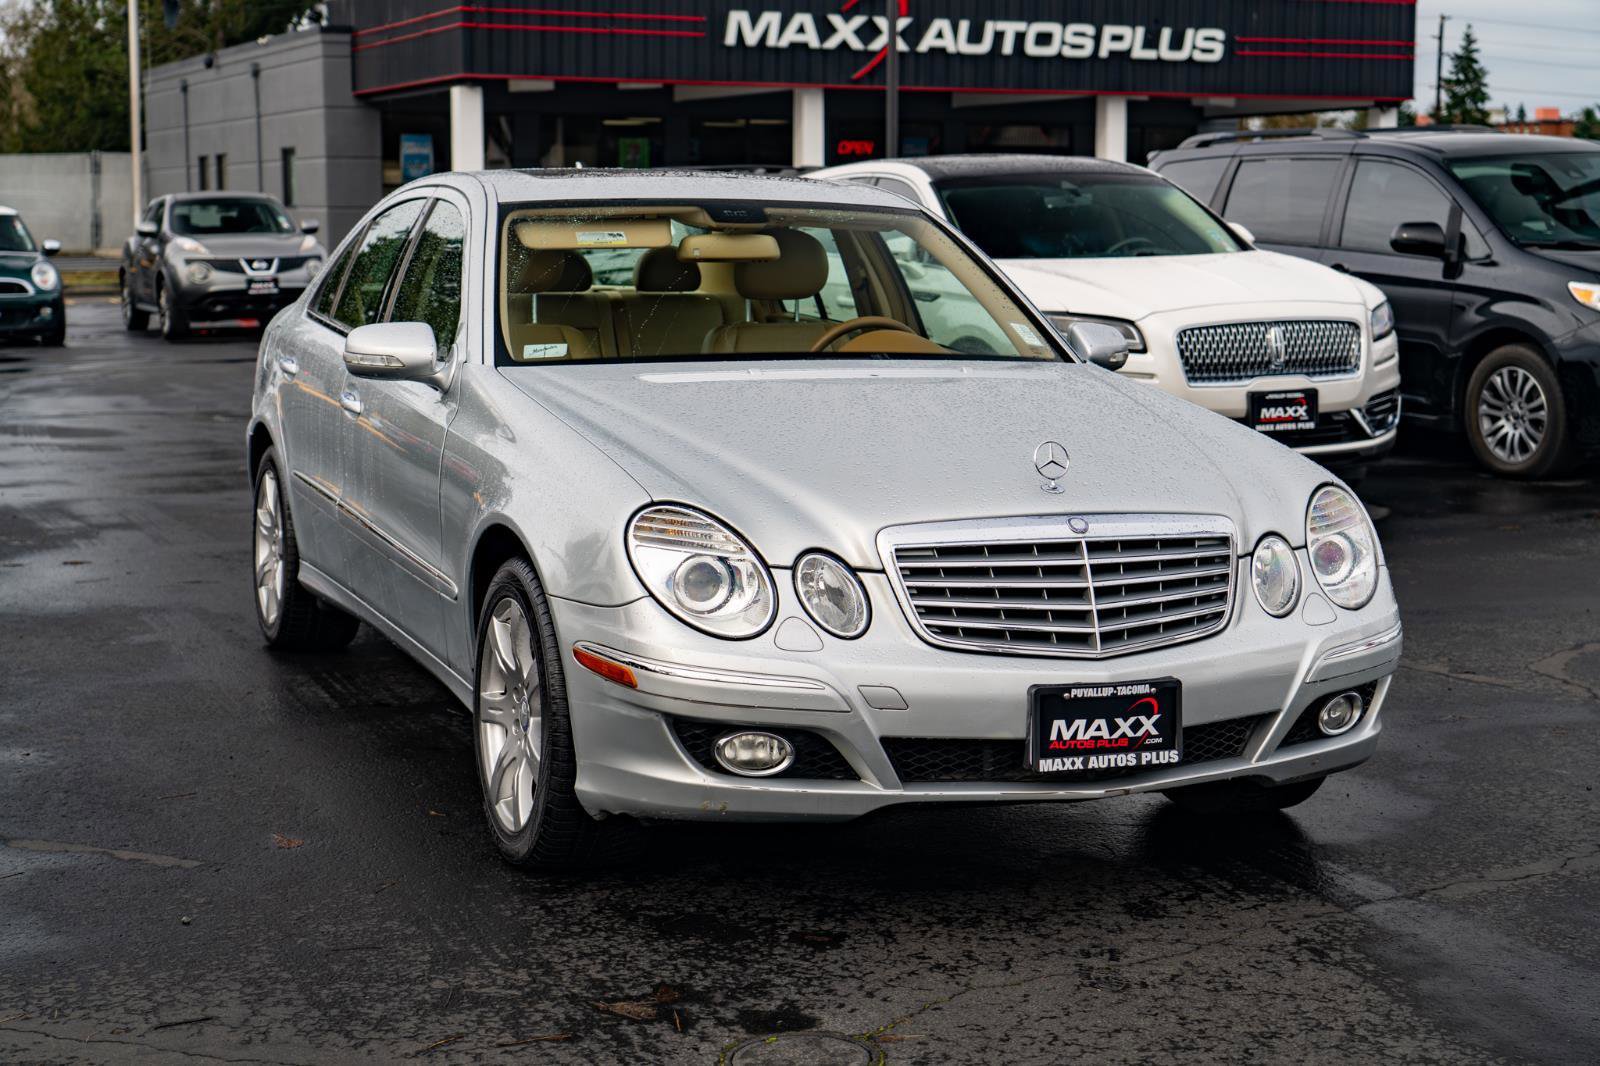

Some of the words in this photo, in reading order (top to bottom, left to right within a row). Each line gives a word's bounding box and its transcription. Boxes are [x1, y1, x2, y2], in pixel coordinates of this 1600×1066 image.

[724, 10, 914, 52] MAXX
[837, 140, 874, 156] OPEN
[1260, 405, 1308, 419] MAXX
[1050, 714, 1162, 740] MAXX
[1049, 739, 1095, 750] AUTOS
[1096, 737, 1129, 748] PLUS
[1039, 757, 1084, 772] MAXX
[1088, 753, 1137, 769] AUTOS
[1141, 750, 1179, 765] PLUS
